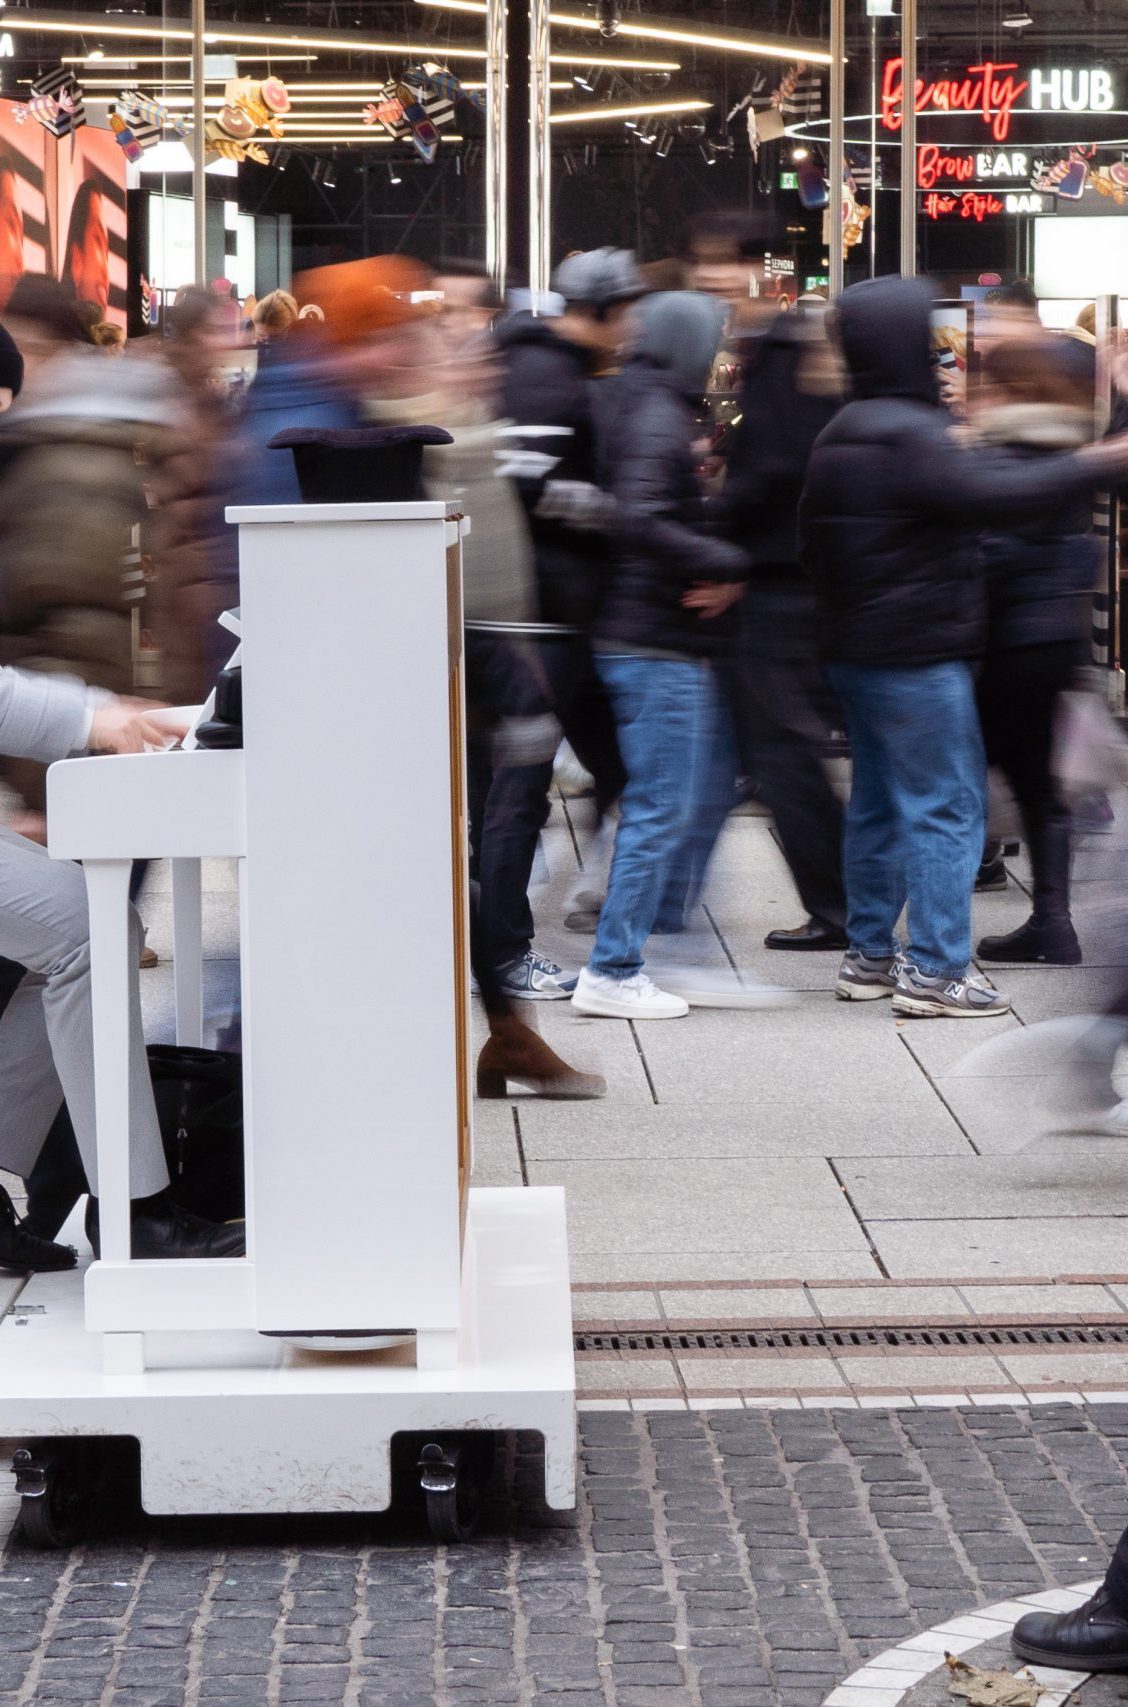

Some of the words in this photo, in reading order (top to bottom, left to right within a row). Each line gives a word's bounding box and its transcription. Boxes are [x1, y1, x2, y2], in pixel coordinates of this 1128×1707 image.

[882, 57, 1028, 141] Beauty
[1030, 68, 1114, 111] HUB
[918, 145, 974, 188] Brow
[976, 153, 1027, 177] BAR
[925, 193, 957, 219] Hair
[961, 192, 1004, 222] Style
[1006, 194, 1042, 213] BAR
[771, 259, 795, 270] SEPHORA
[944, 981, 964, 998] N
